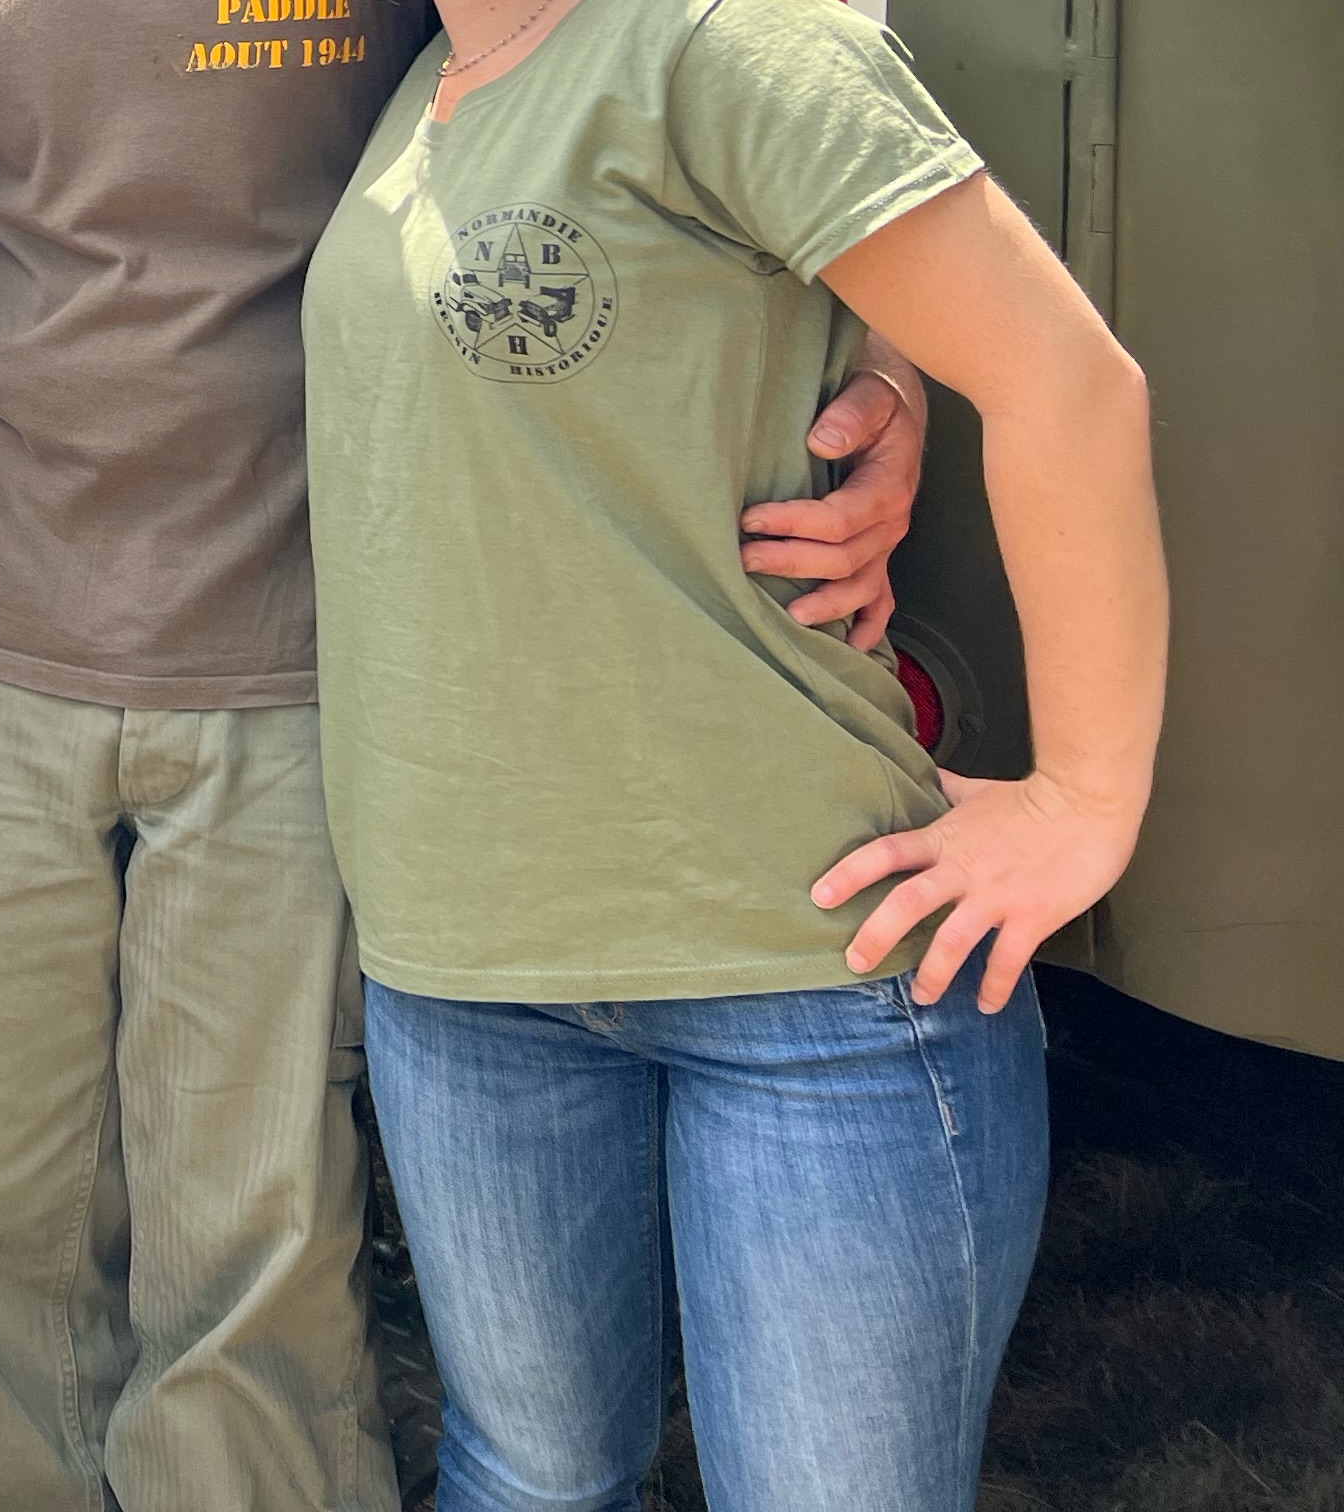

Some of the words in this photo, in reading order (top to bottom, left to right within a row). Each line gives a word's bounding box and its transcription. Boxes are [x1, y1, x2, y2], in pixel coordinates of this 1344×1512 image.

[186, 39, 289, 73] AOUT
[301, 35, 366, 69] 1944
[458, 209, 583, 244] NORMANDIE
[474, 241, 494, 262] N
[541, 243, 561, 265] B
[507, 335, 528, 356] H
